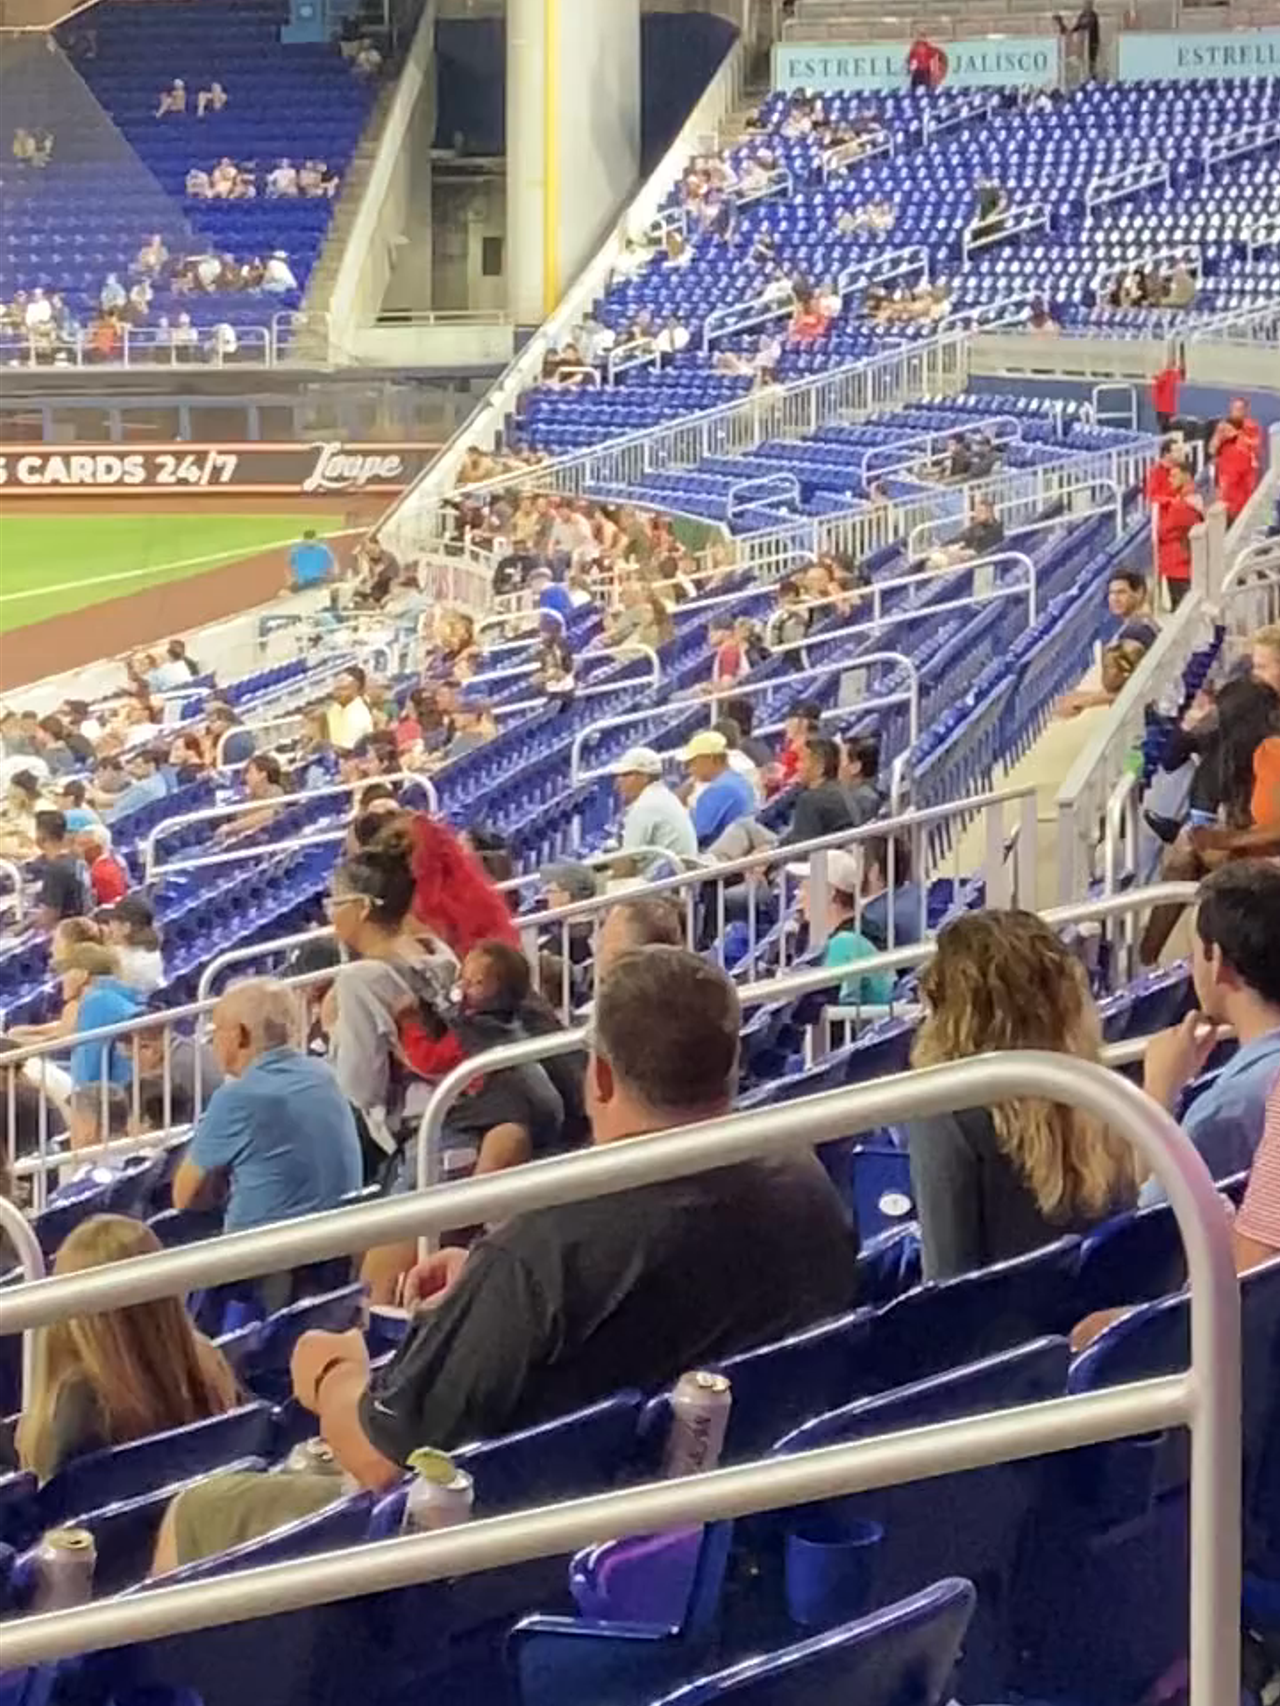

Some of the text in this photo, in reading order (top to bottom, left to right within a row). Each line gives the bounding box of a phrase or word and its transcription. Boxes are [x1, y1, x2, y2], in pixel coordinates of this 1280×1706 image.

[952, 50, 1049, 74] JALISCO
[16, 454, 146, 484] CARDS
[155, 449, 238, 486] 24/7
